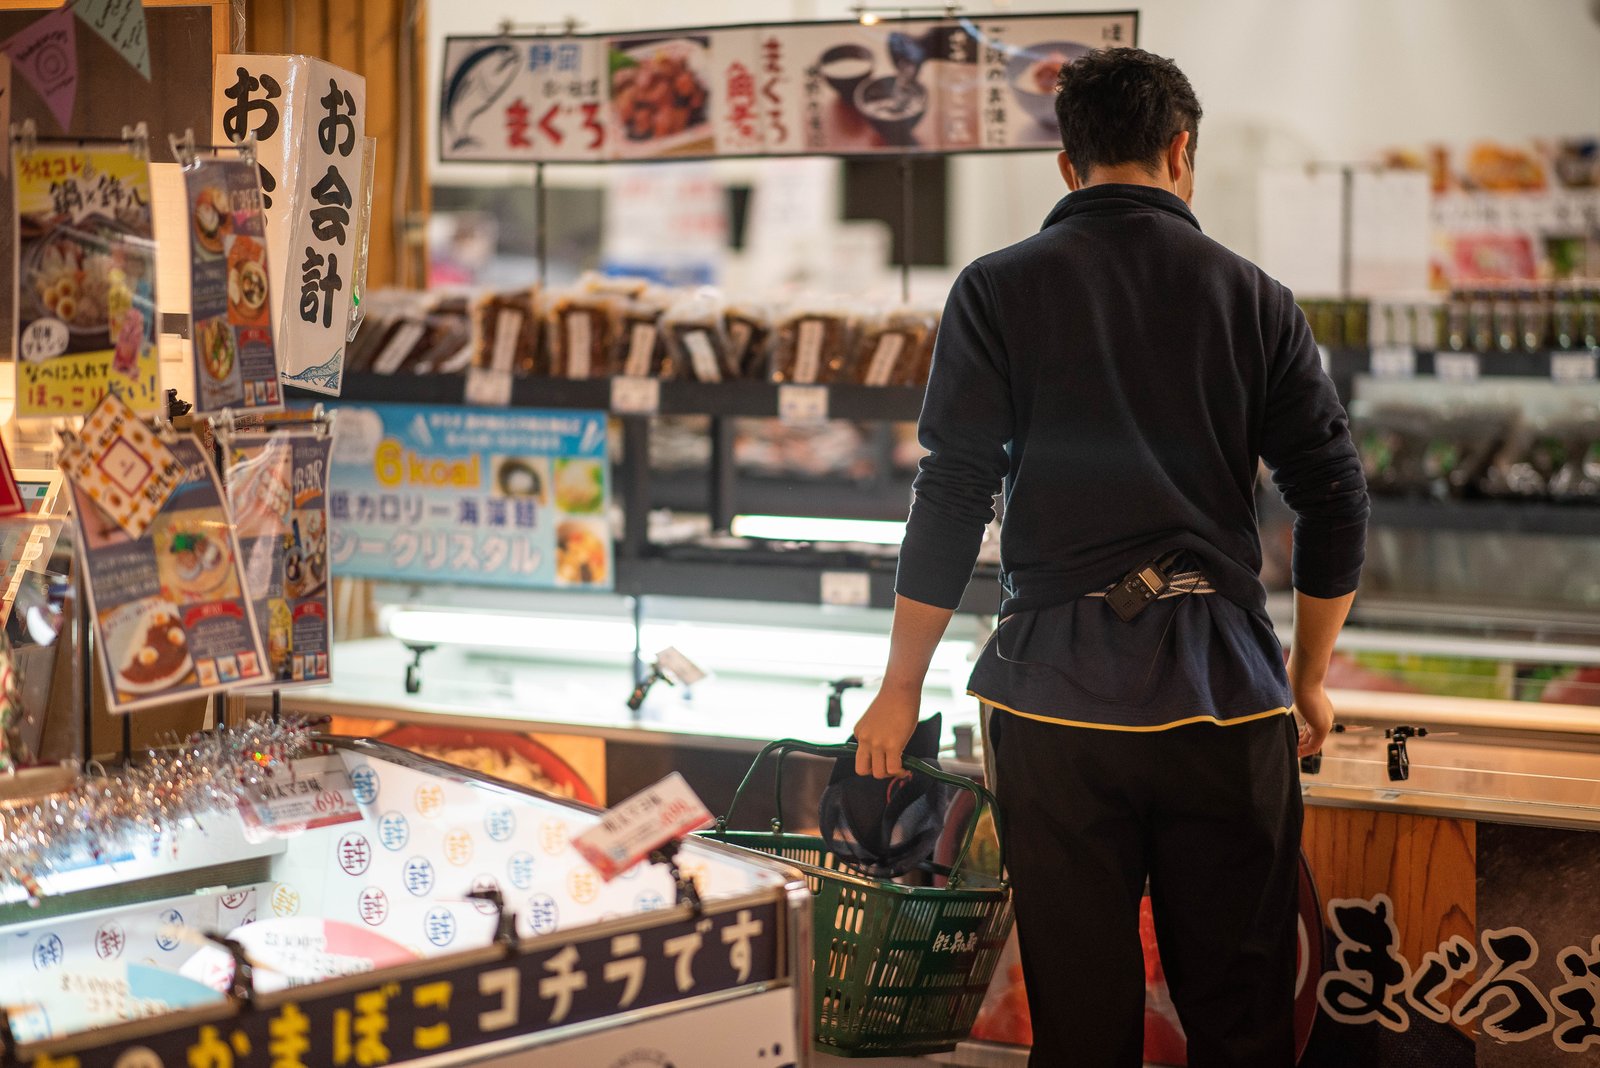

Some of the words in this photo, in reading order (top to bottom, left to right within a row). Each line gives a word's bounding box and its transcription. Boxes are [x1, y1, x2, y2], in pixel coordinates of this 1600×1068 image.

[504, 97, 606, 149] まぐろ
[300, 77, 357, 329] お会計
